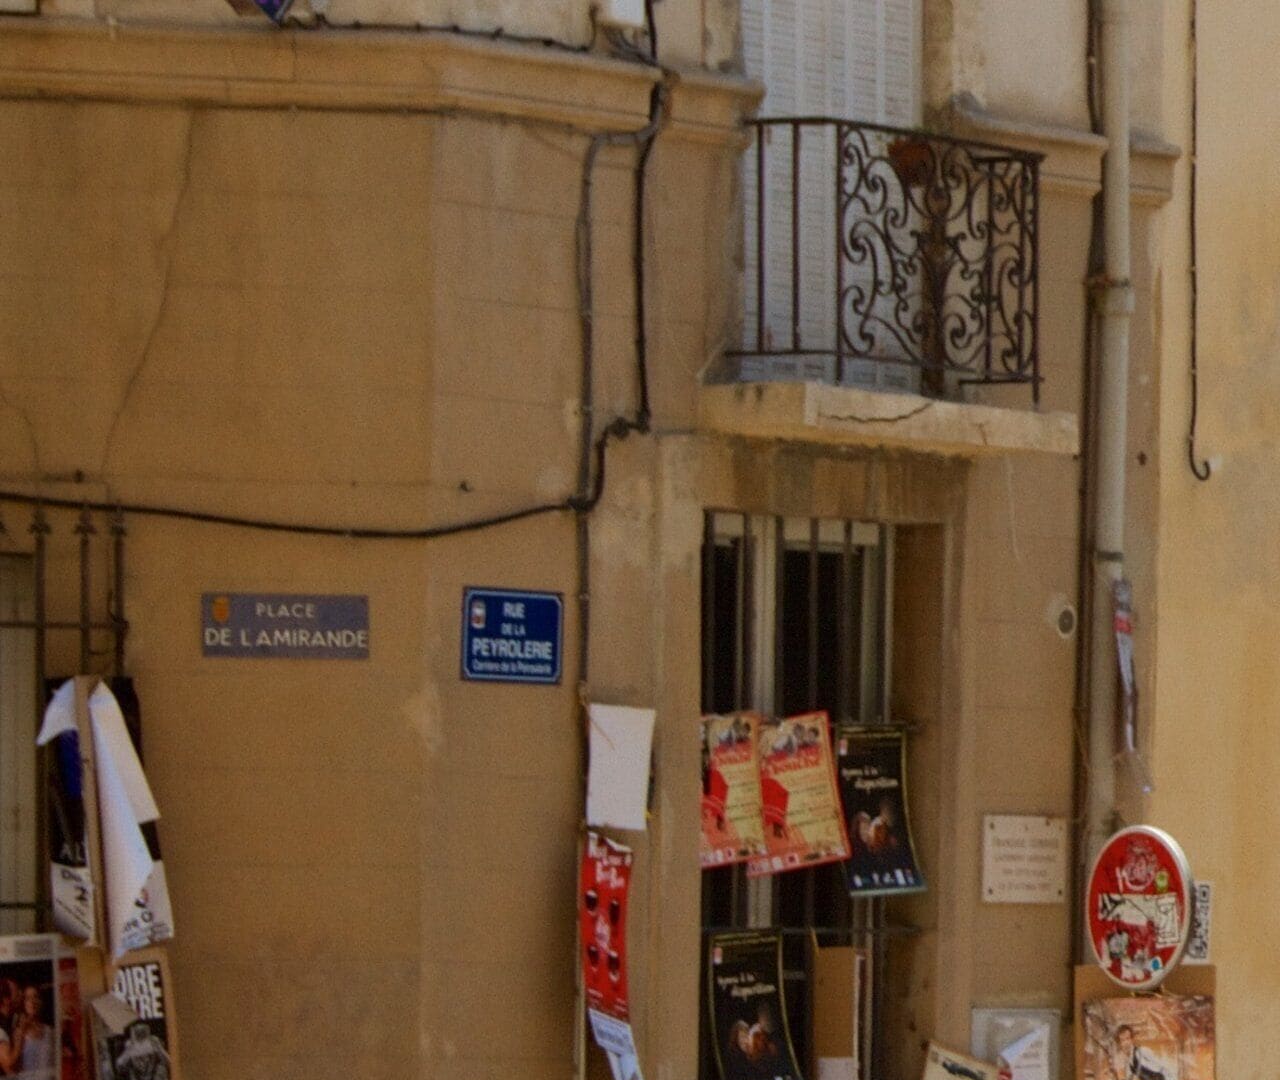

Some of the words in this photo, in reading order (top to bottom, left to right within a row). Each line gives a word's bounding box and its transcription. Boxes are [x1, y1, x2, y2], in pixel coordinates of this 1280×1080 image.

[256, 602, 315, 618] PLACE
[503, 602, 525, 618] RUE
[204, 628, 231, 646] DE
[471, 638, 552, 660] PEYROLERIE
